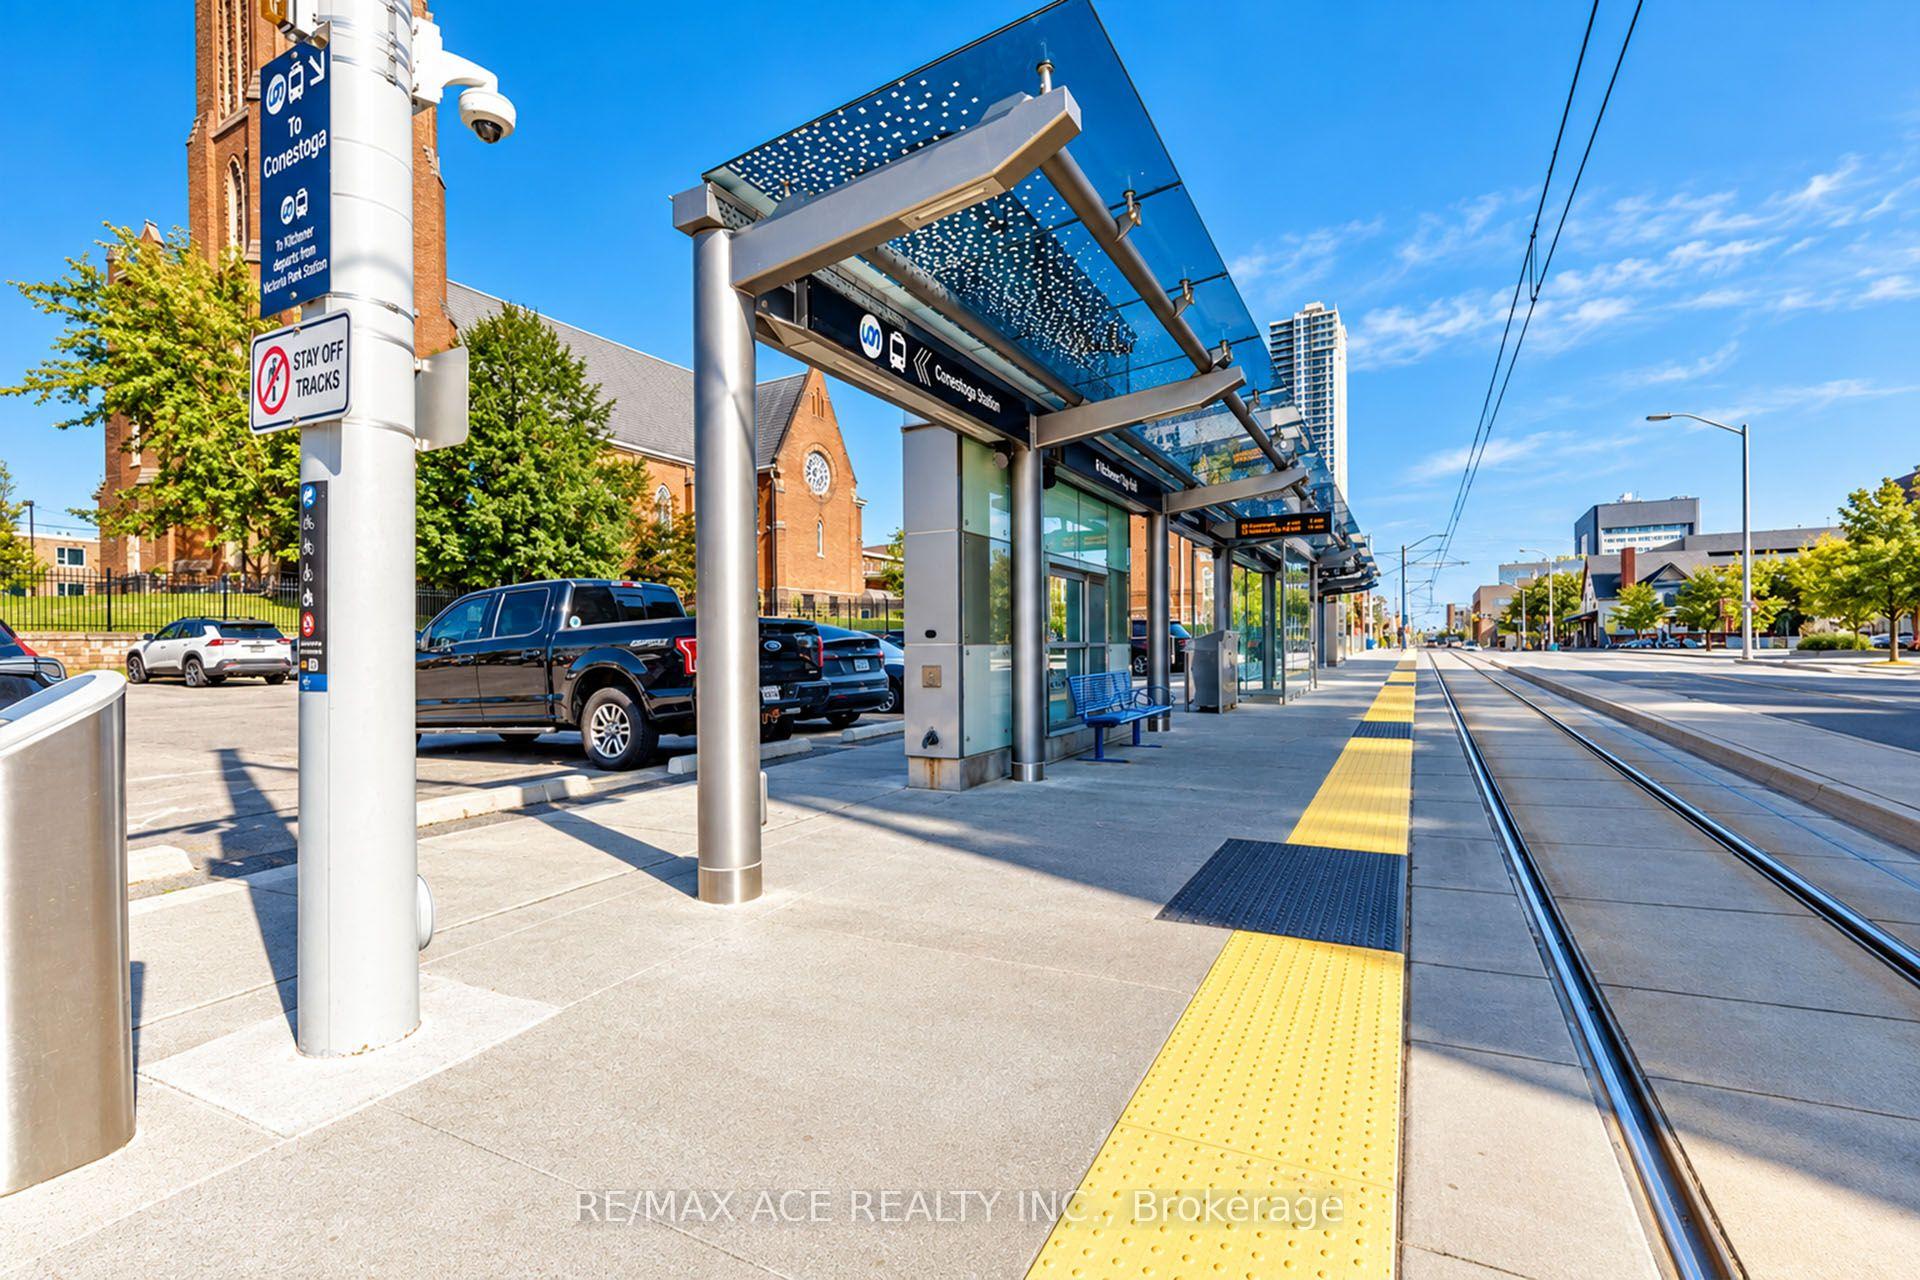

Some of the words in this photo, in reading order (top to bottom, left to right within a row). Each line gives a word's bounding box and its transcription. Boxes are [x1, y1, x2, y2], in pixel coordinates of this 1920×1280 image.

[288, 115, 302, 138] To
[263, 129, 327, 178] Conestoga
[293, 346, 320, 371] STAY
[321, 339, 344, 364] OFF
[295, 369, 340, 398] TRACKS
[934, 364, 977, 402] Conestoga
[976, 387, 1001, 413] Station
